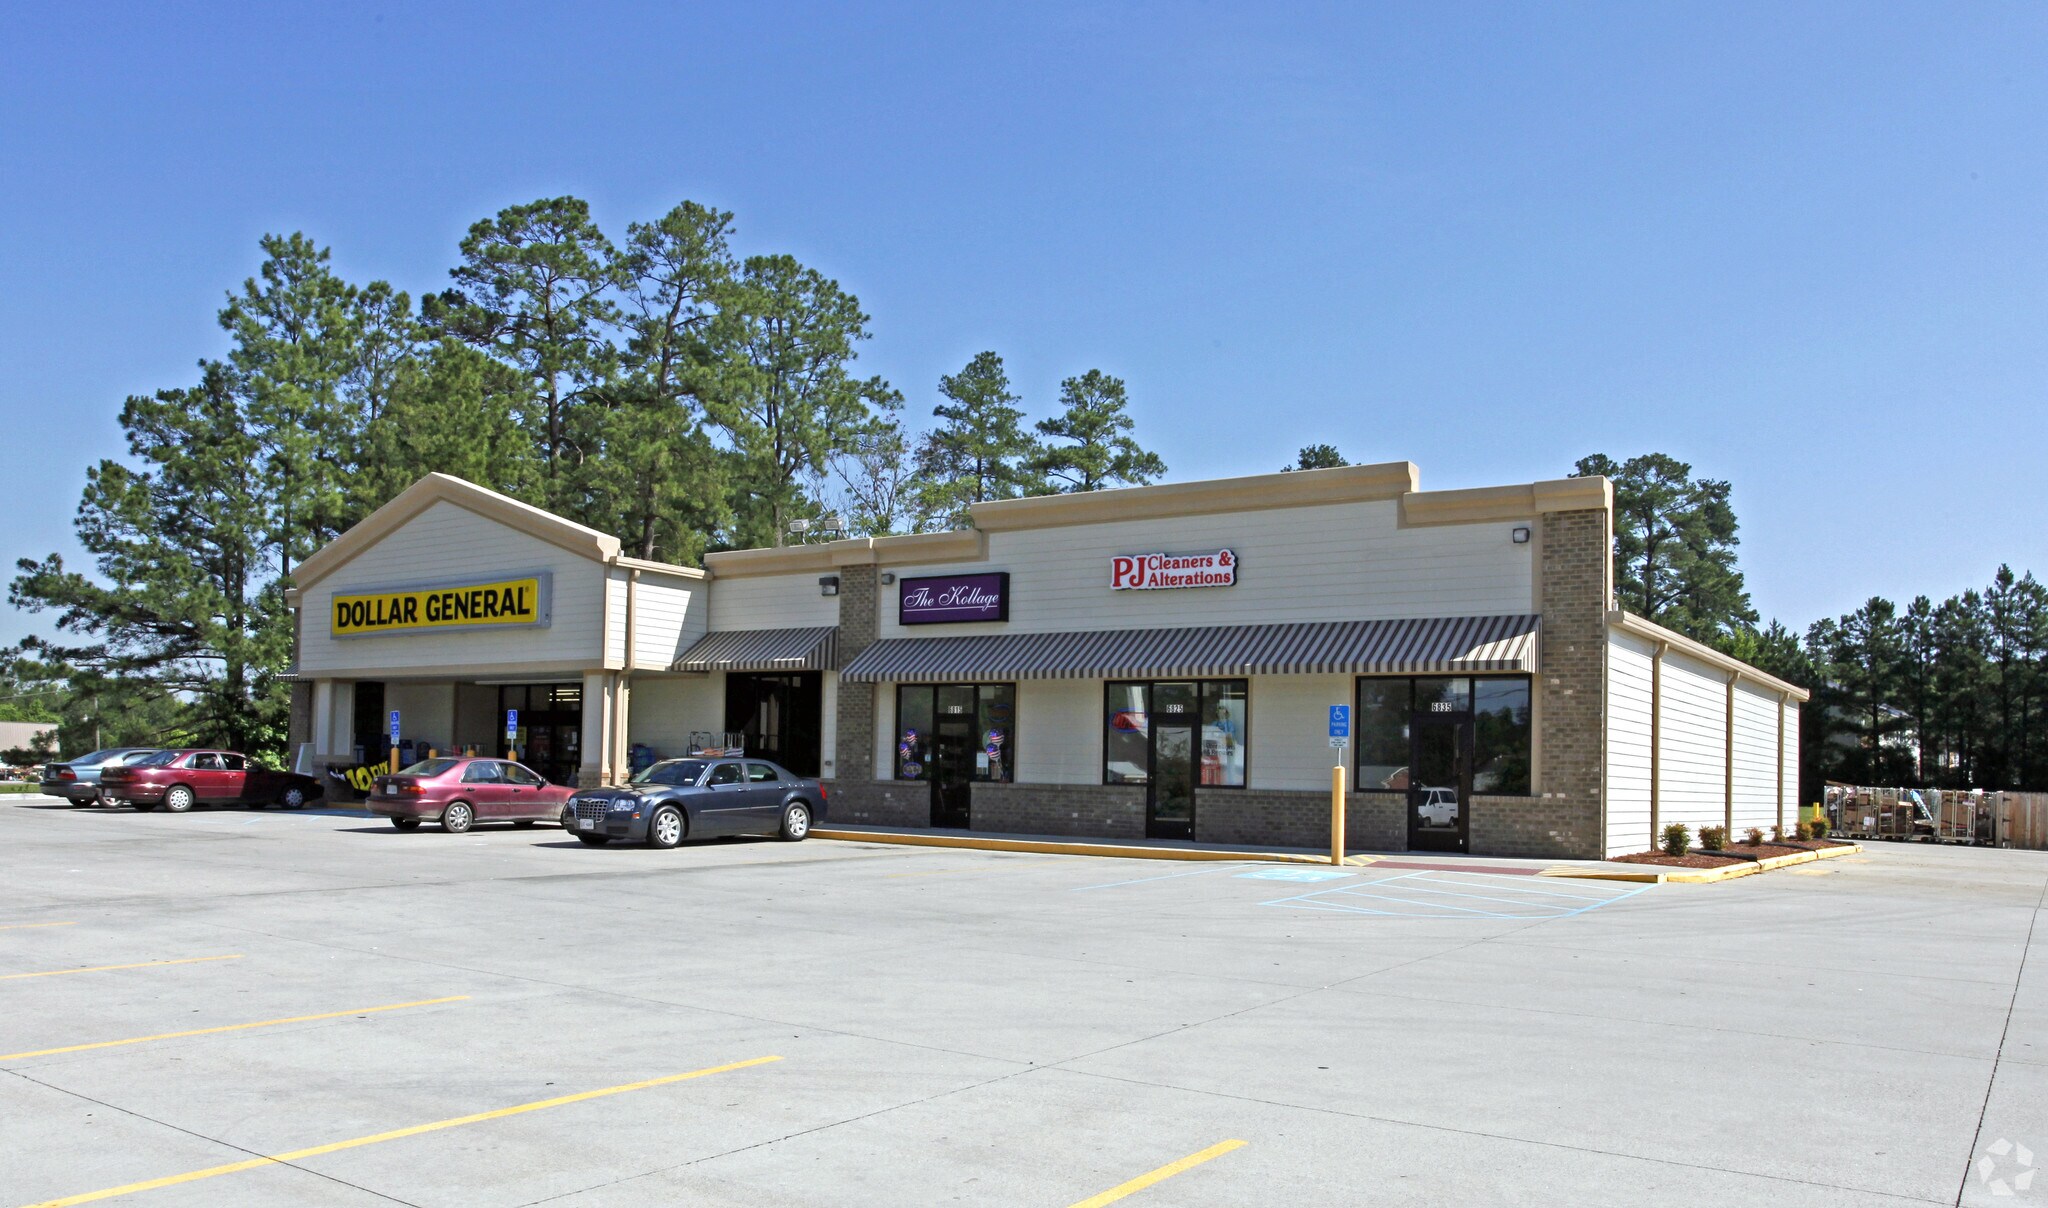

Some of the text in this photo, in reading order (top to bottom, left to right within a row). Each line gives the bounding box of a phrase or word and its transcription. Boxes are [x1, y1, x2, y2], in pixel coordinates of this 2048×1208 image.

[1112, 557, 1146, 587] PJ
[1147, 551, 1232, 571] Cleaners &
[1147, 571, 1231, 587] Alterations
[337, 586, 531, 628] DOLLAR GENERAL
[903, 585, 999, 612] The Kollage
[1166, 704, 1184, 714] 6825
[1431, 702, 1452, 712] 6835
[345, 766, 373, 792] 10
